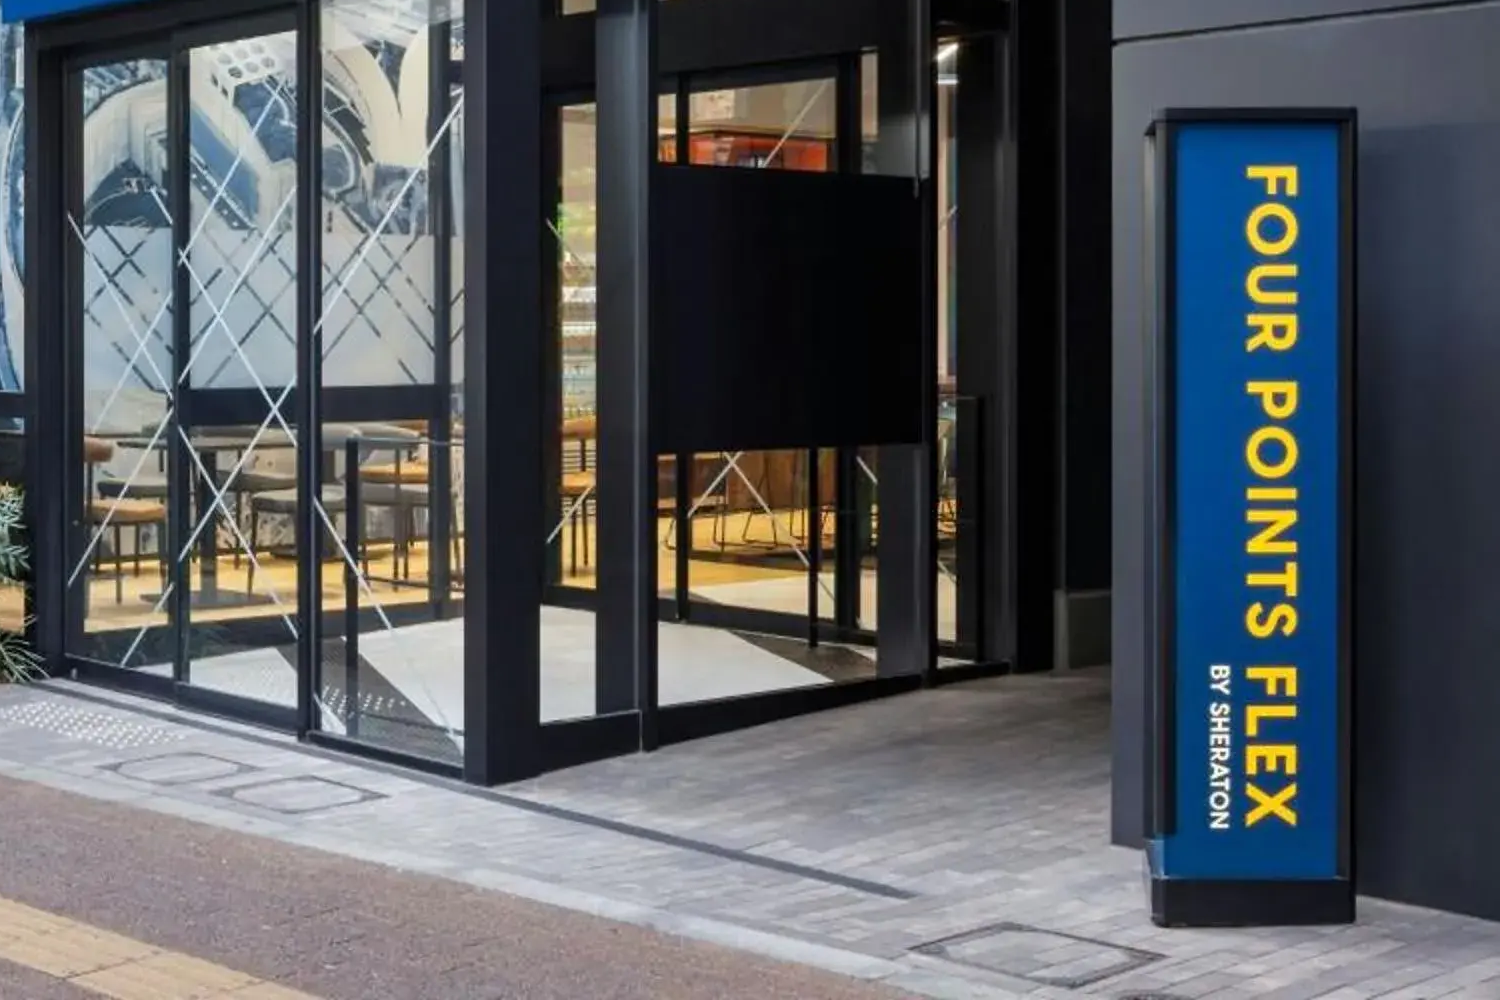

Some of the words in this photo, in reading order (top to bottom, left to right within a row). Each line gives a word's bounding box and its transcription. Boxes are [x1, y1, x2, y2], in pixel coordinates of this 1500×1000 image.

[1245, 164, 1299, 353] FOUR
[1245, 380, 1299, 639] POINTS
[1209, 664, 1231, 696] BY
[1244, 666, 1298, 827] FLEX
[1209, 701, 1231, 829] SHERATON
